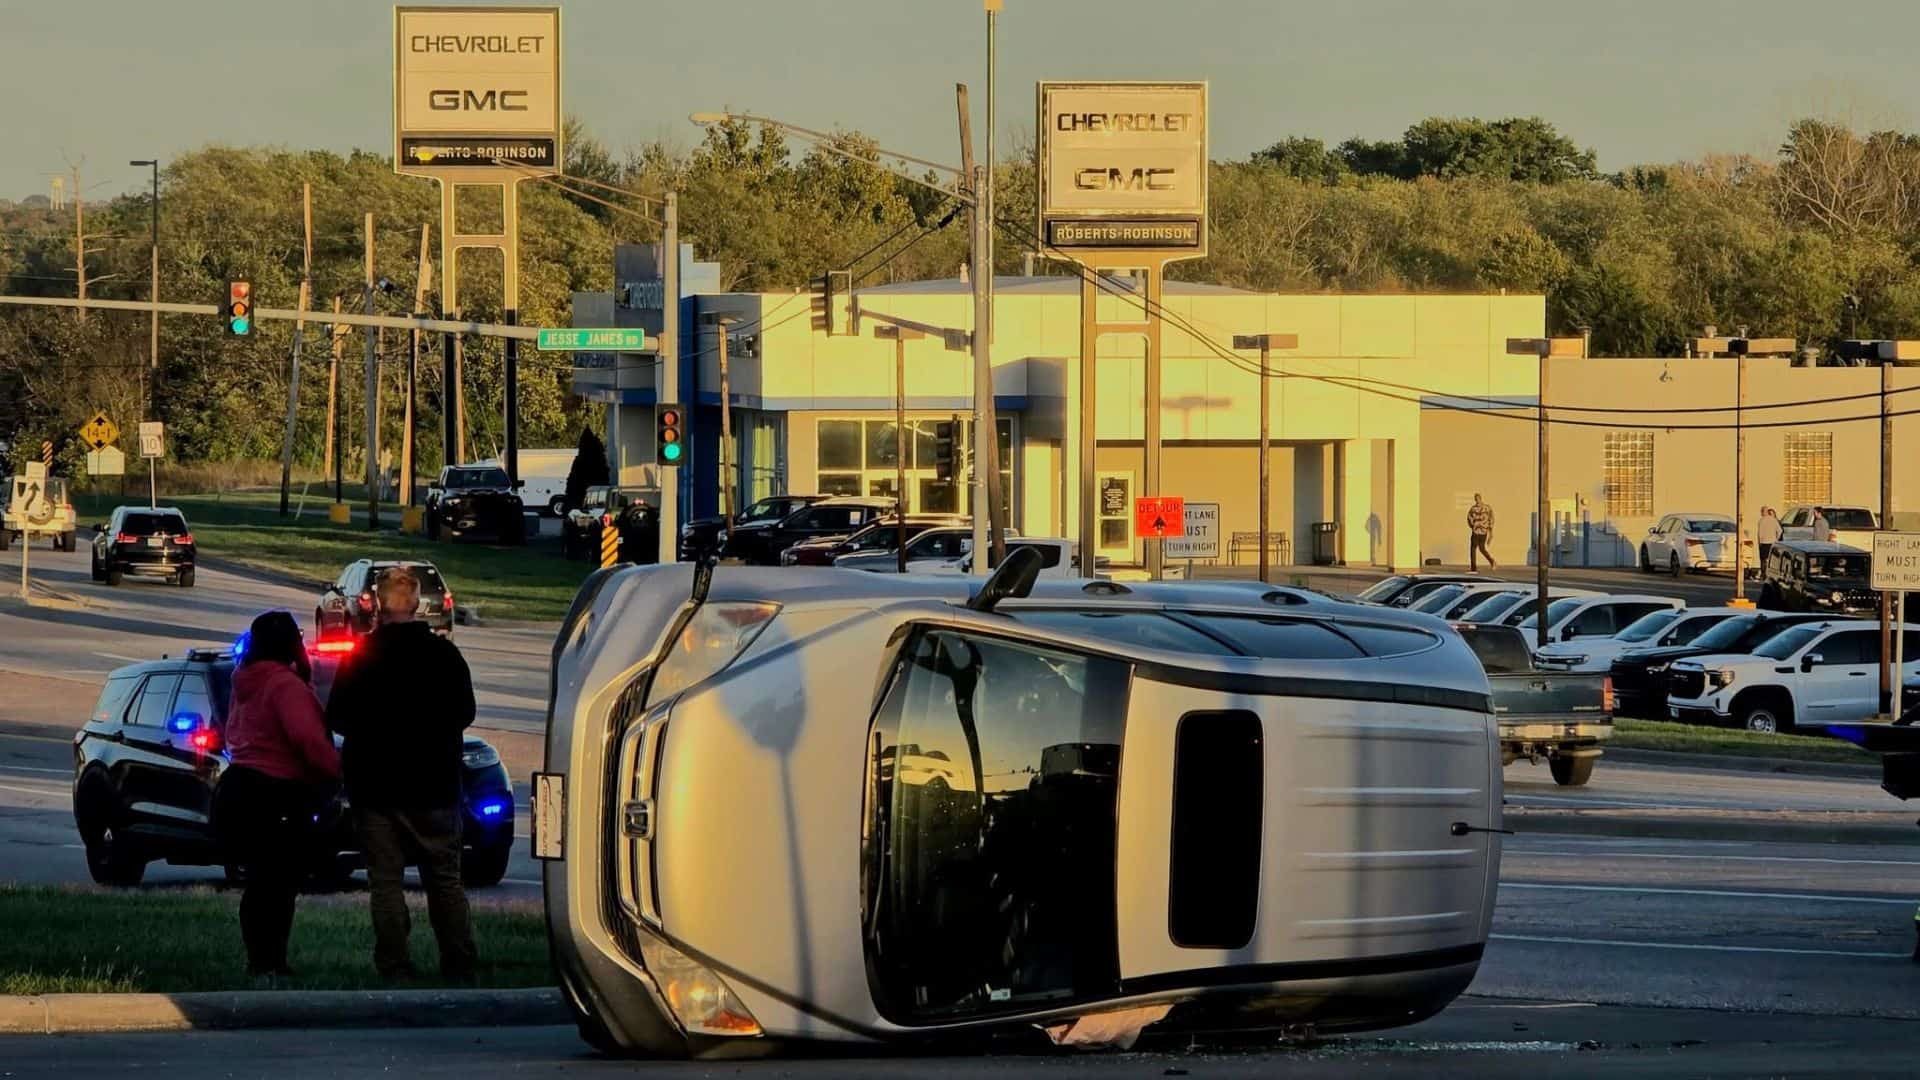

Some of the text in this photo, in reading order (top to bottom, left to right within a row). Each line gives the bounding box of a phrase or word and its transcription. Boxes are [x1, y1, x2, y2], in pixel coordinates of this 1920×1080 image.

[411, 35, 545, 53] CHEVROLET
[429, 89, 528, 111] GMC
[1057, 113, 1193, 131] CHEVROLET
[409, 146, 547, 159] RRTS-ROBINSON
[1074, 167, 1176, 190] GMC
[1056, 227, 1193, 240] ROBERTS-ROBINSON
[544, 333, 639, 346] JESSE JAMES RD
[1139, 503, 1182, 513] DETOUR
[1194, 510, 1216, 520] LANE
[1186, 525, 1208, 537] UST
[1168, 542, 1217, 552] TURN RIGHT
[1876, 539, 1920, 550] RIGHT LAN
[1886, 556, 1917, 568] MUST
[1876, 573, 1920, 583] TURN RIGH
